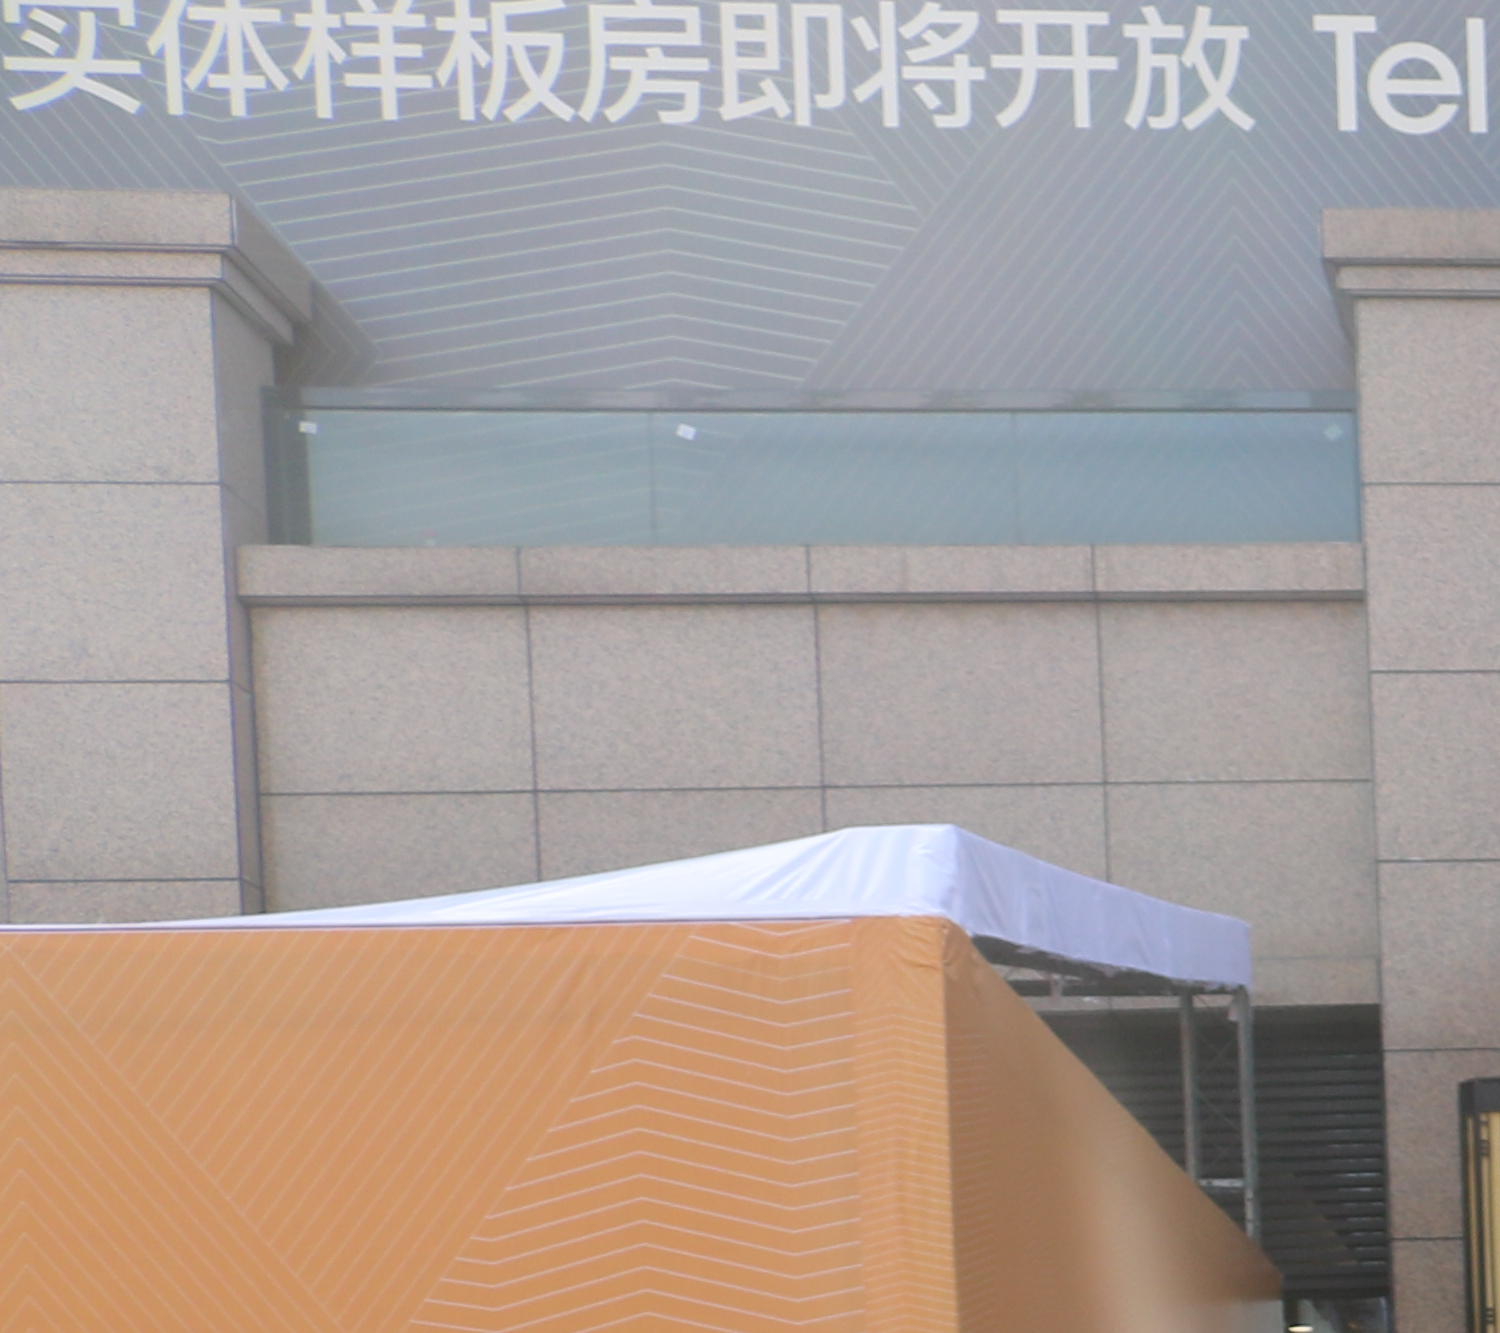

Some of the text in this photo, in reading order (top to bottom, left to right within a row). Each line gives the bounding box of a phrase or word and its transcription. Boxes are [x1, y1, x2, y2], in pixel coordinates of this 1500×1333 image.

[0, 0, 1257, 130] 实体样板房即将开放
